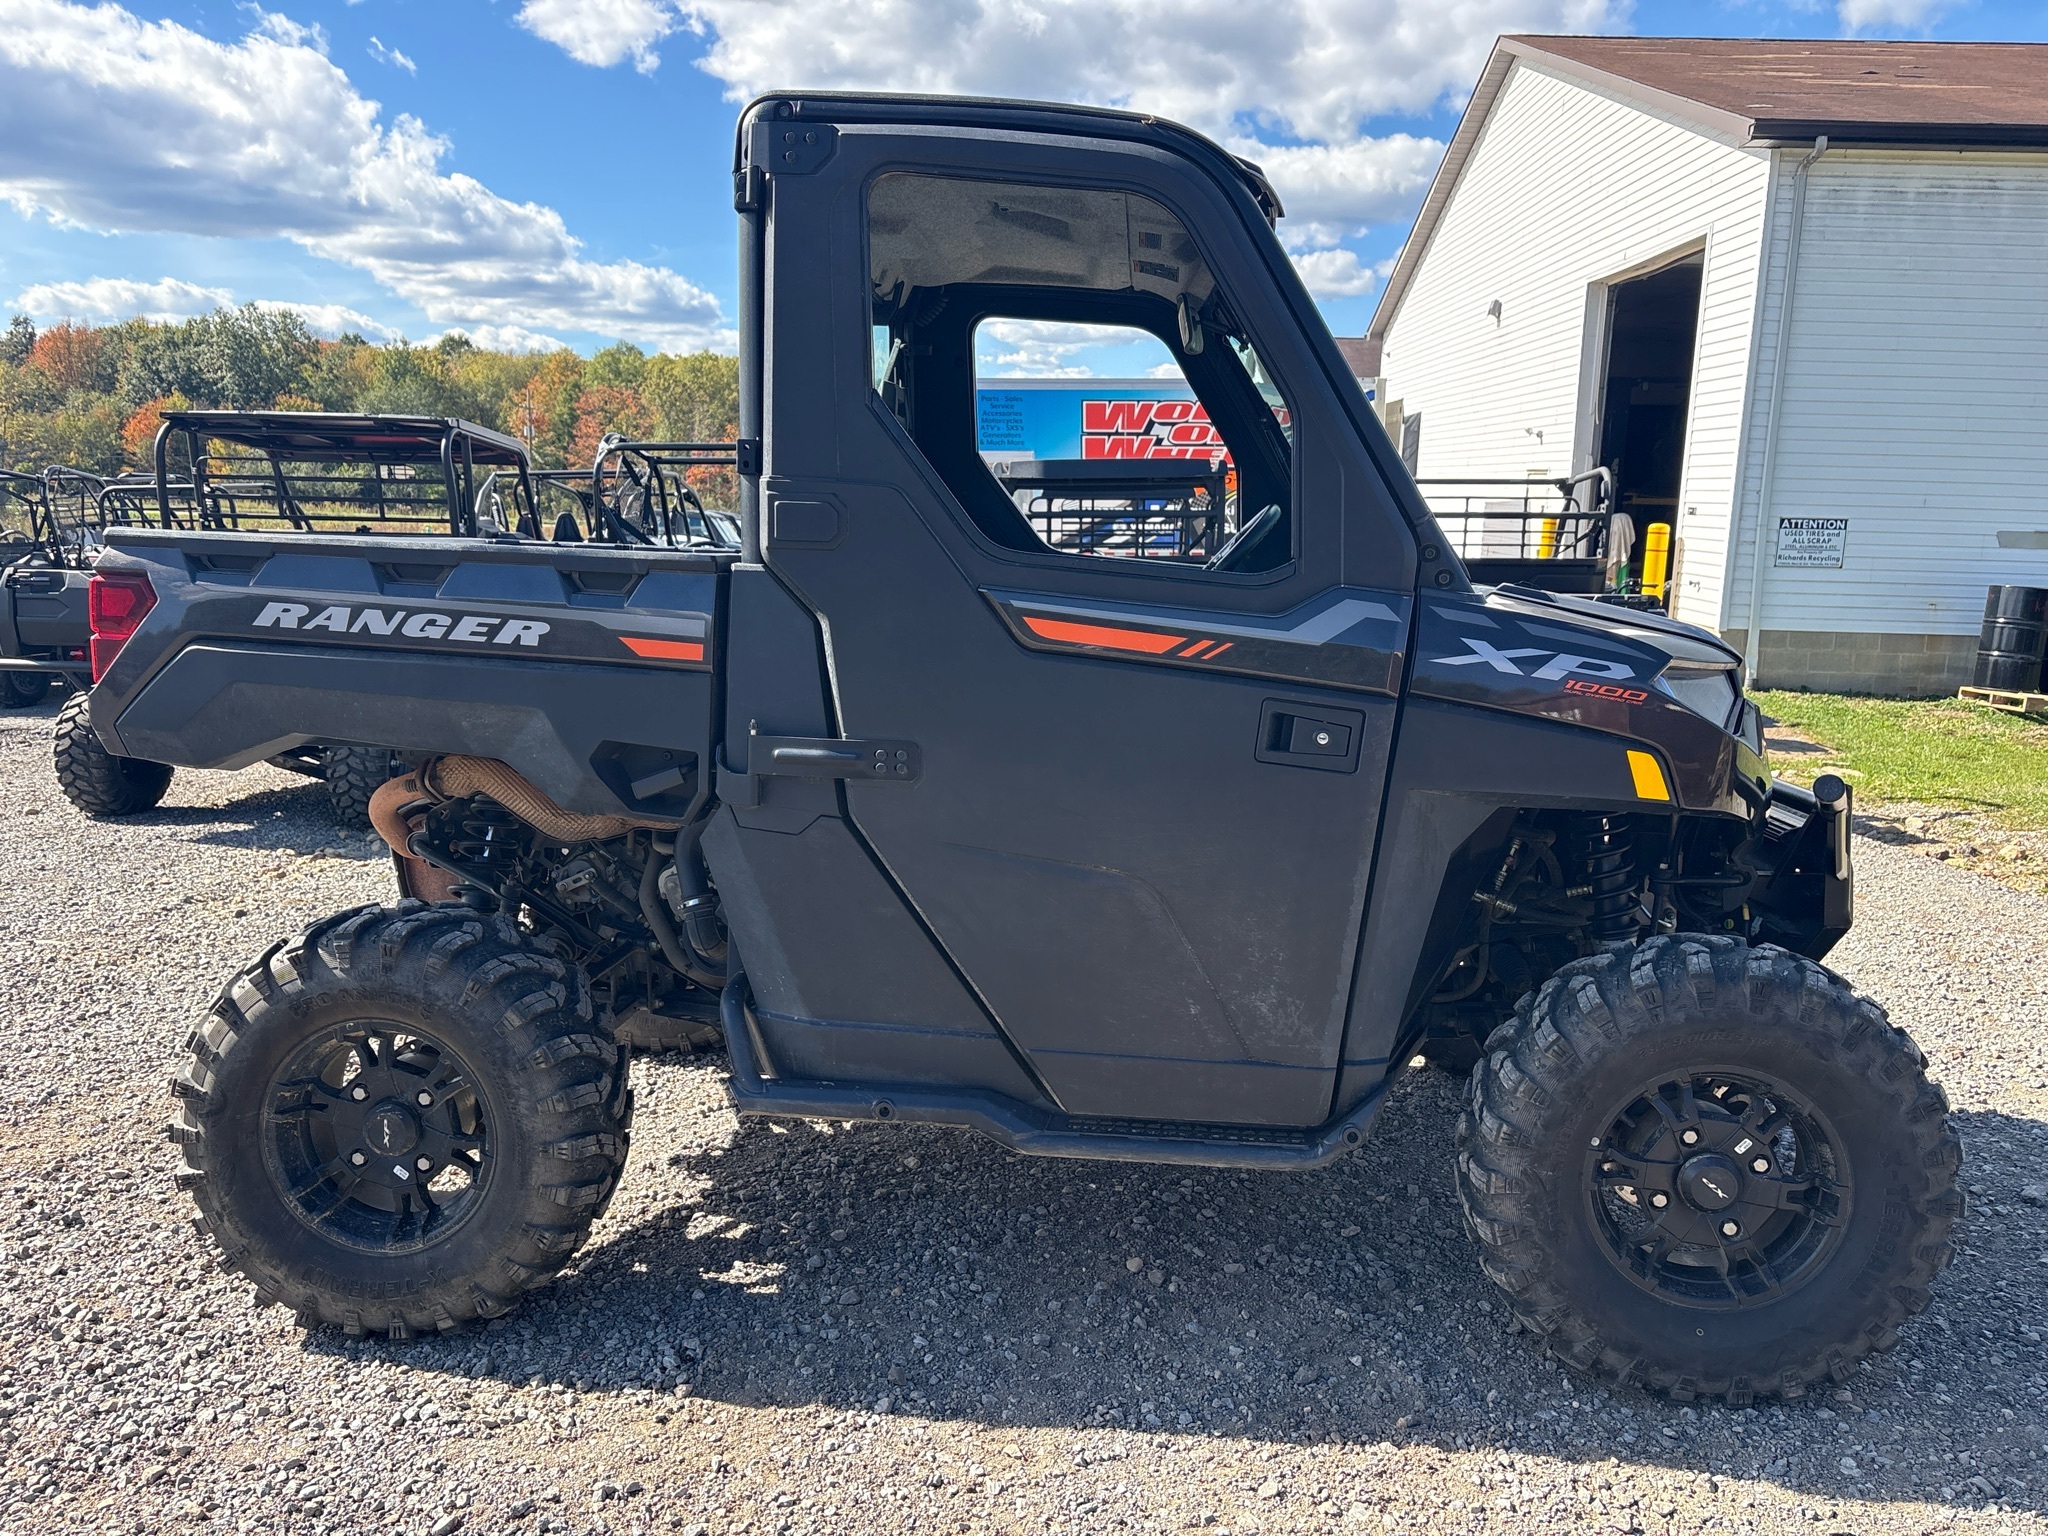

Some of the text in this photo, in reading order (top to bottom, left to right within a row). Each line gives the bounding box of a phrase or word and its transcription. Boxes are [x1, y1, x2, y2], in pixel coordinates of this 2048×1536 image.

[981, 418, 1023, 428] Motorcycles
[1781, 518, 1846, 530] ATTENTION
[1784, 529, 1804, 537] USED
[1791, 537, 1806, 545] ALL
[1778, 553, 1840, 563] Richards Recycling
[251, 601, 551, 647] RANGER
[1427, 636, 1637, 682] XP
[1563, 688, 1583, 696] DUAL
[1584, 692, 1626, 703] OVERHEAD
[1564, 679, 1648, 701] 1000
[301, 1265, 449, 1300] X-TERRAIN
